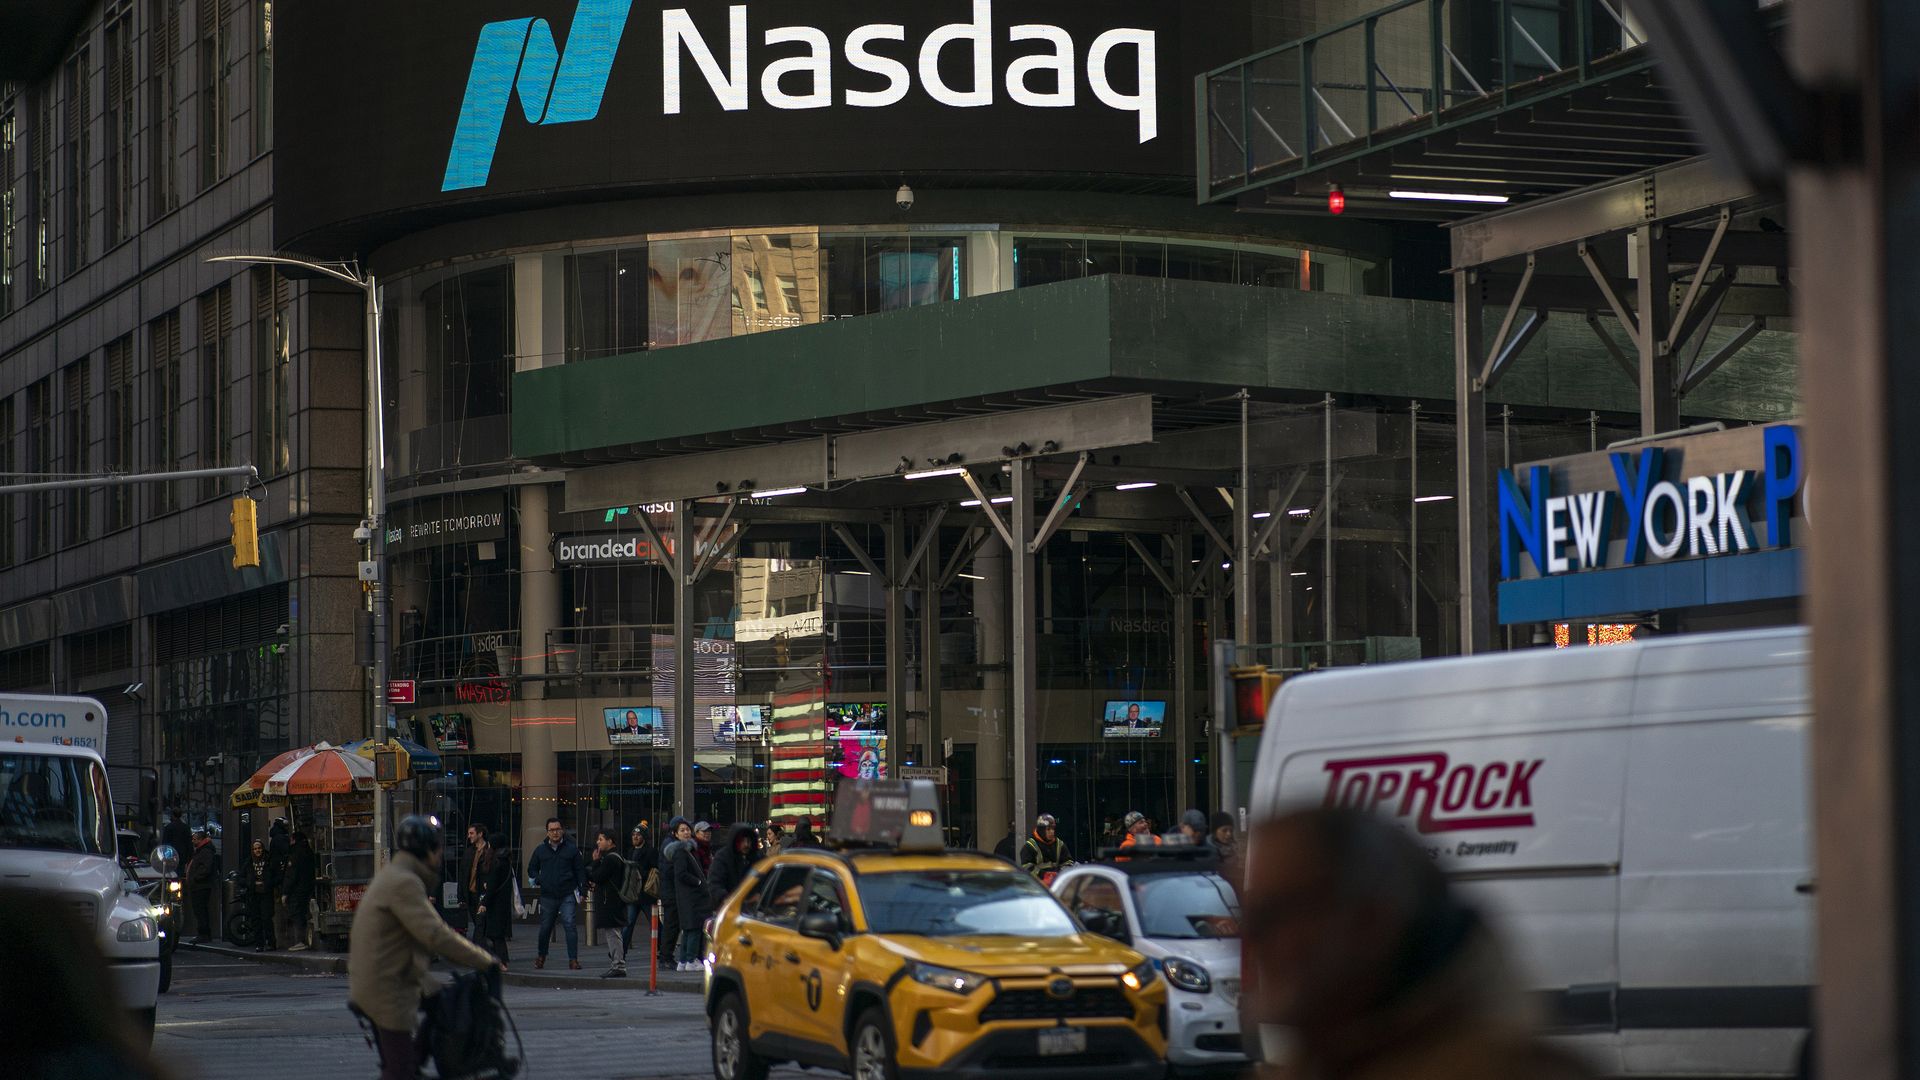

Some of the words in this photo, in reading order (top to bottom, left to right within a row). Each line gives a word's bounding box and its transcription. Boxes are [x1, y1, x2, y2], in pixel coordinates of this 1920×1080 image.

[662, 0, 1157, 144] Nasdaq
[410, 520, 441, 537] REWRITE
[443, 513, 501, 532] TOMORROW
[1499, 464, 1606, 579] NEW
[1609, 447, 1750, 563] YORK
[1762, 425, 1810, 547] P
[1323, 751, 1545, 835] TOPROCK
[1455, 841, 1518, 858] Carpentry
